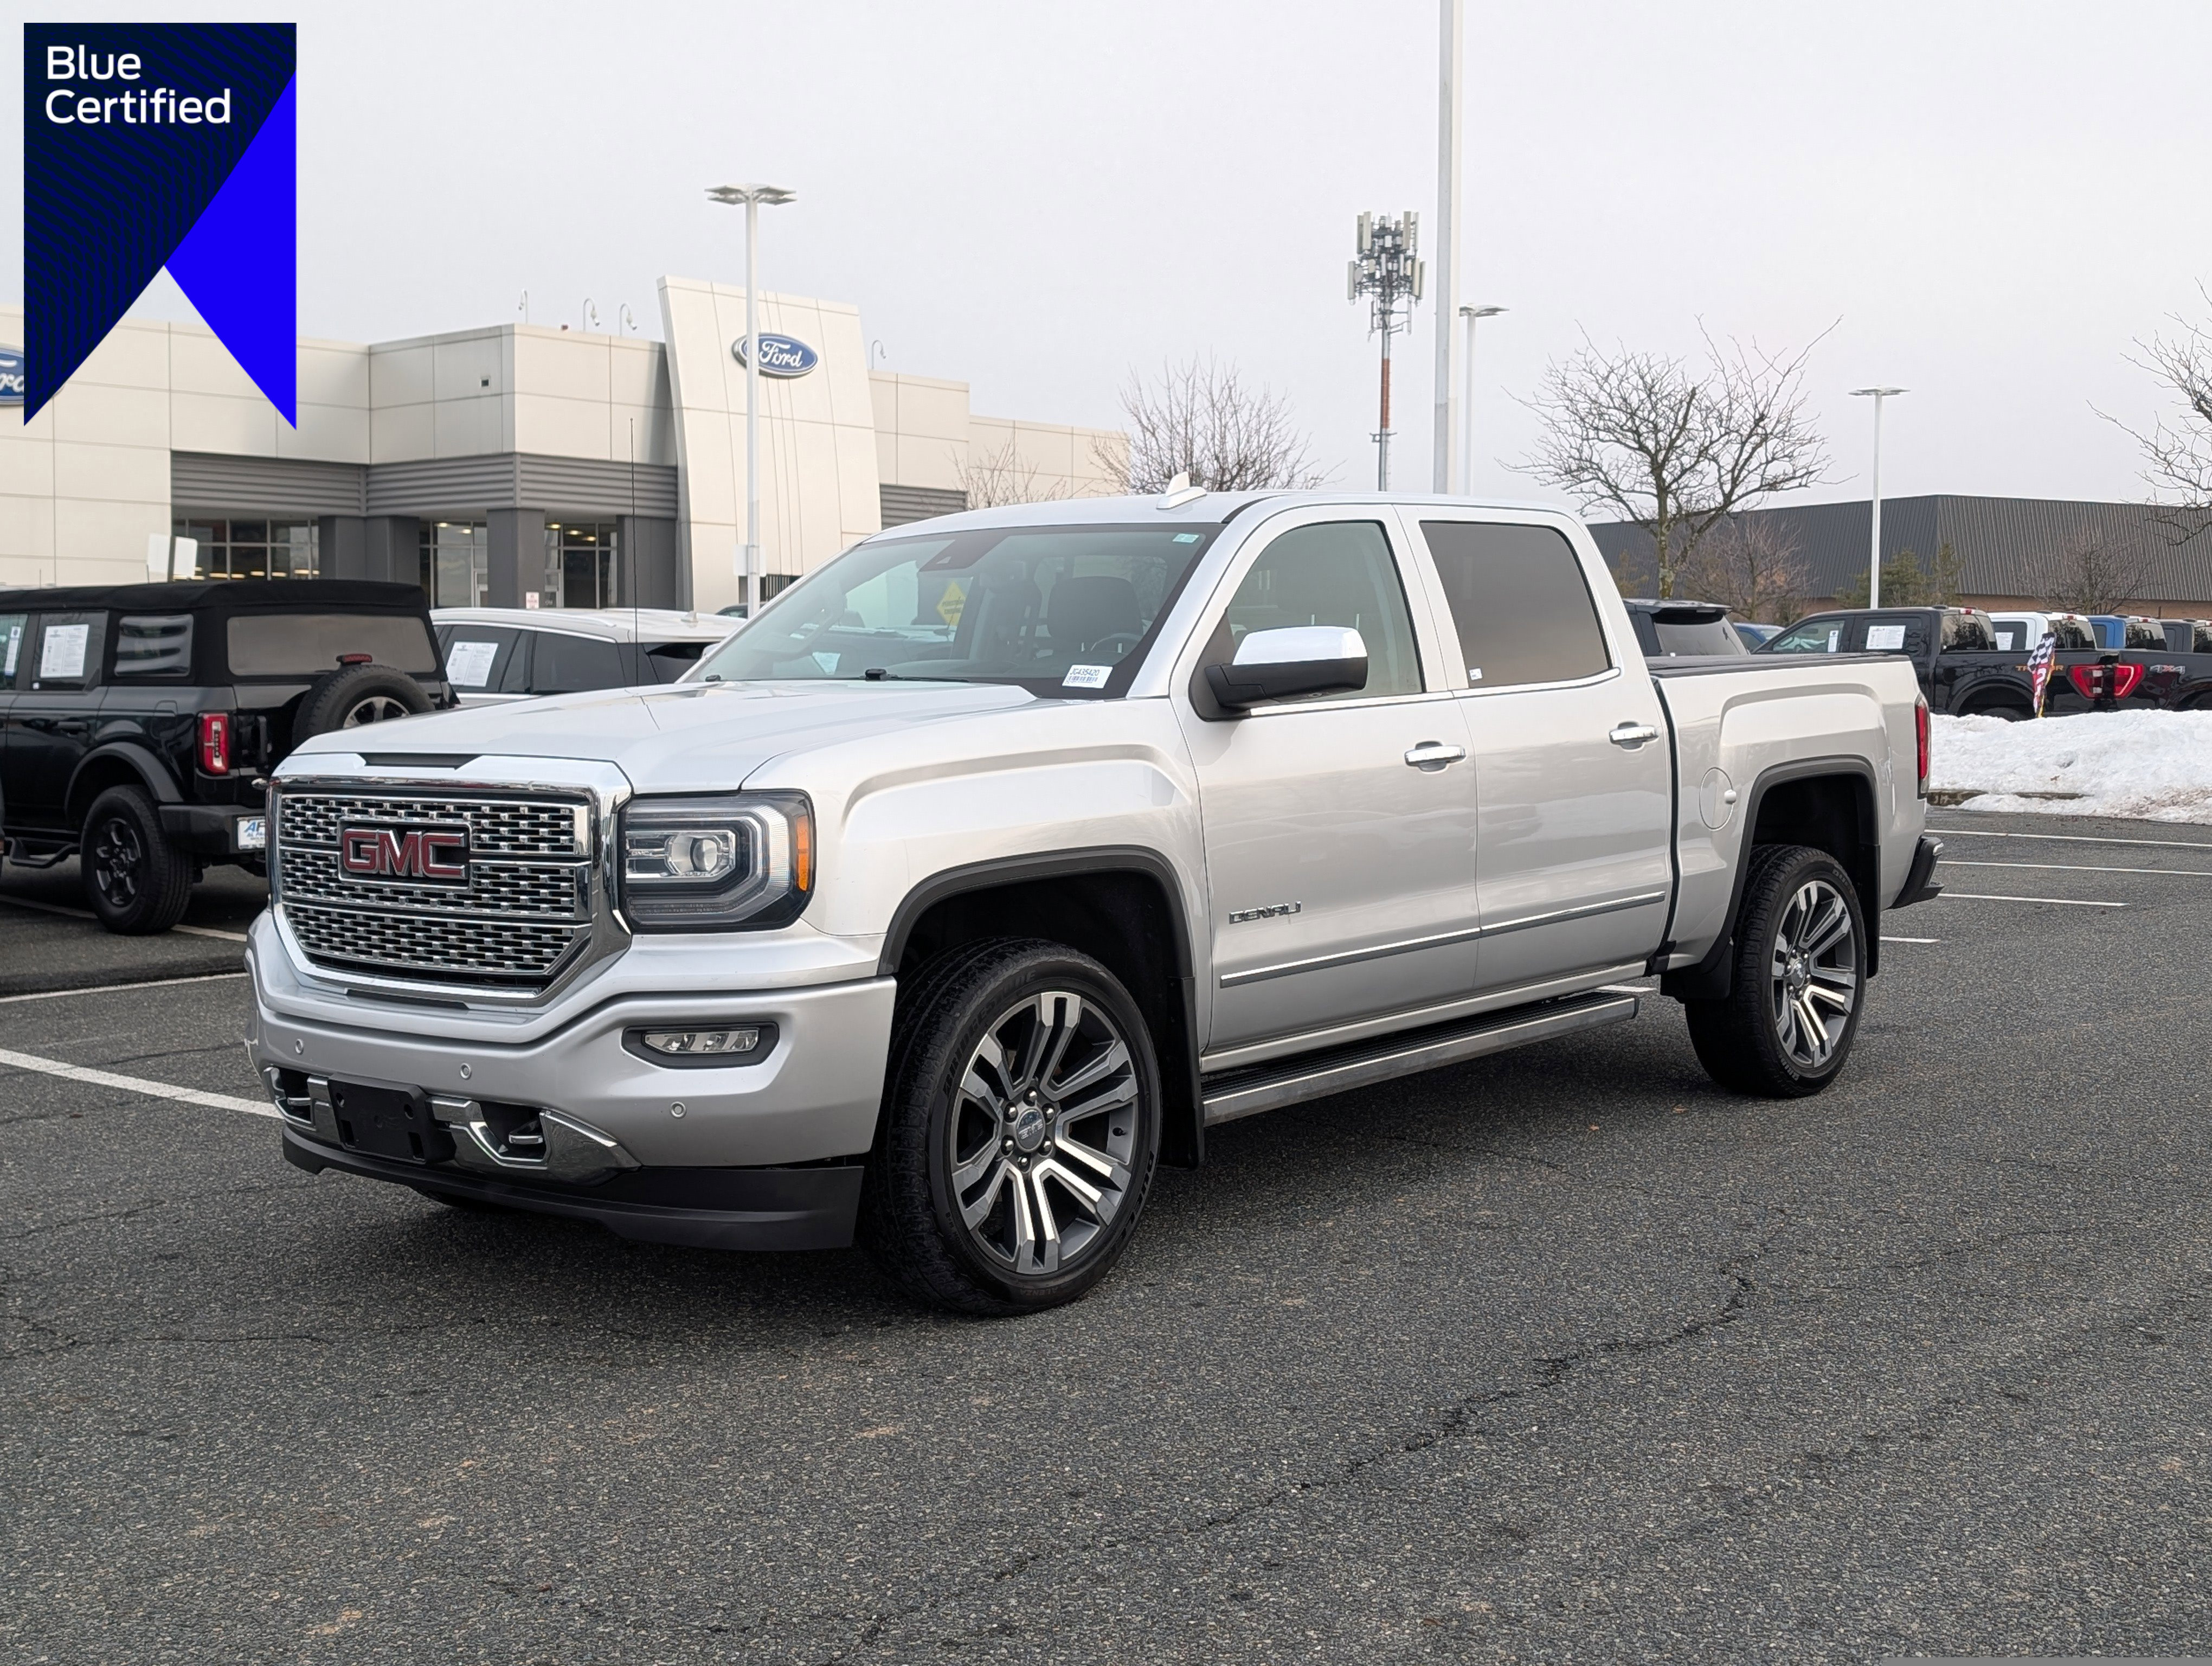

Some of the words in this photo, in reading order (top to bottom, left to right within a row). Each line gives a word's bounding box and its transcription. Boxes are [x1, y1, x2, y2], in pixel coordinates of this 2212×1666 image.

[759, 341, 803, 367] Ford
[343, 828, 467, 879] GMC
[1229, 901, 1301, 924] DENALI
